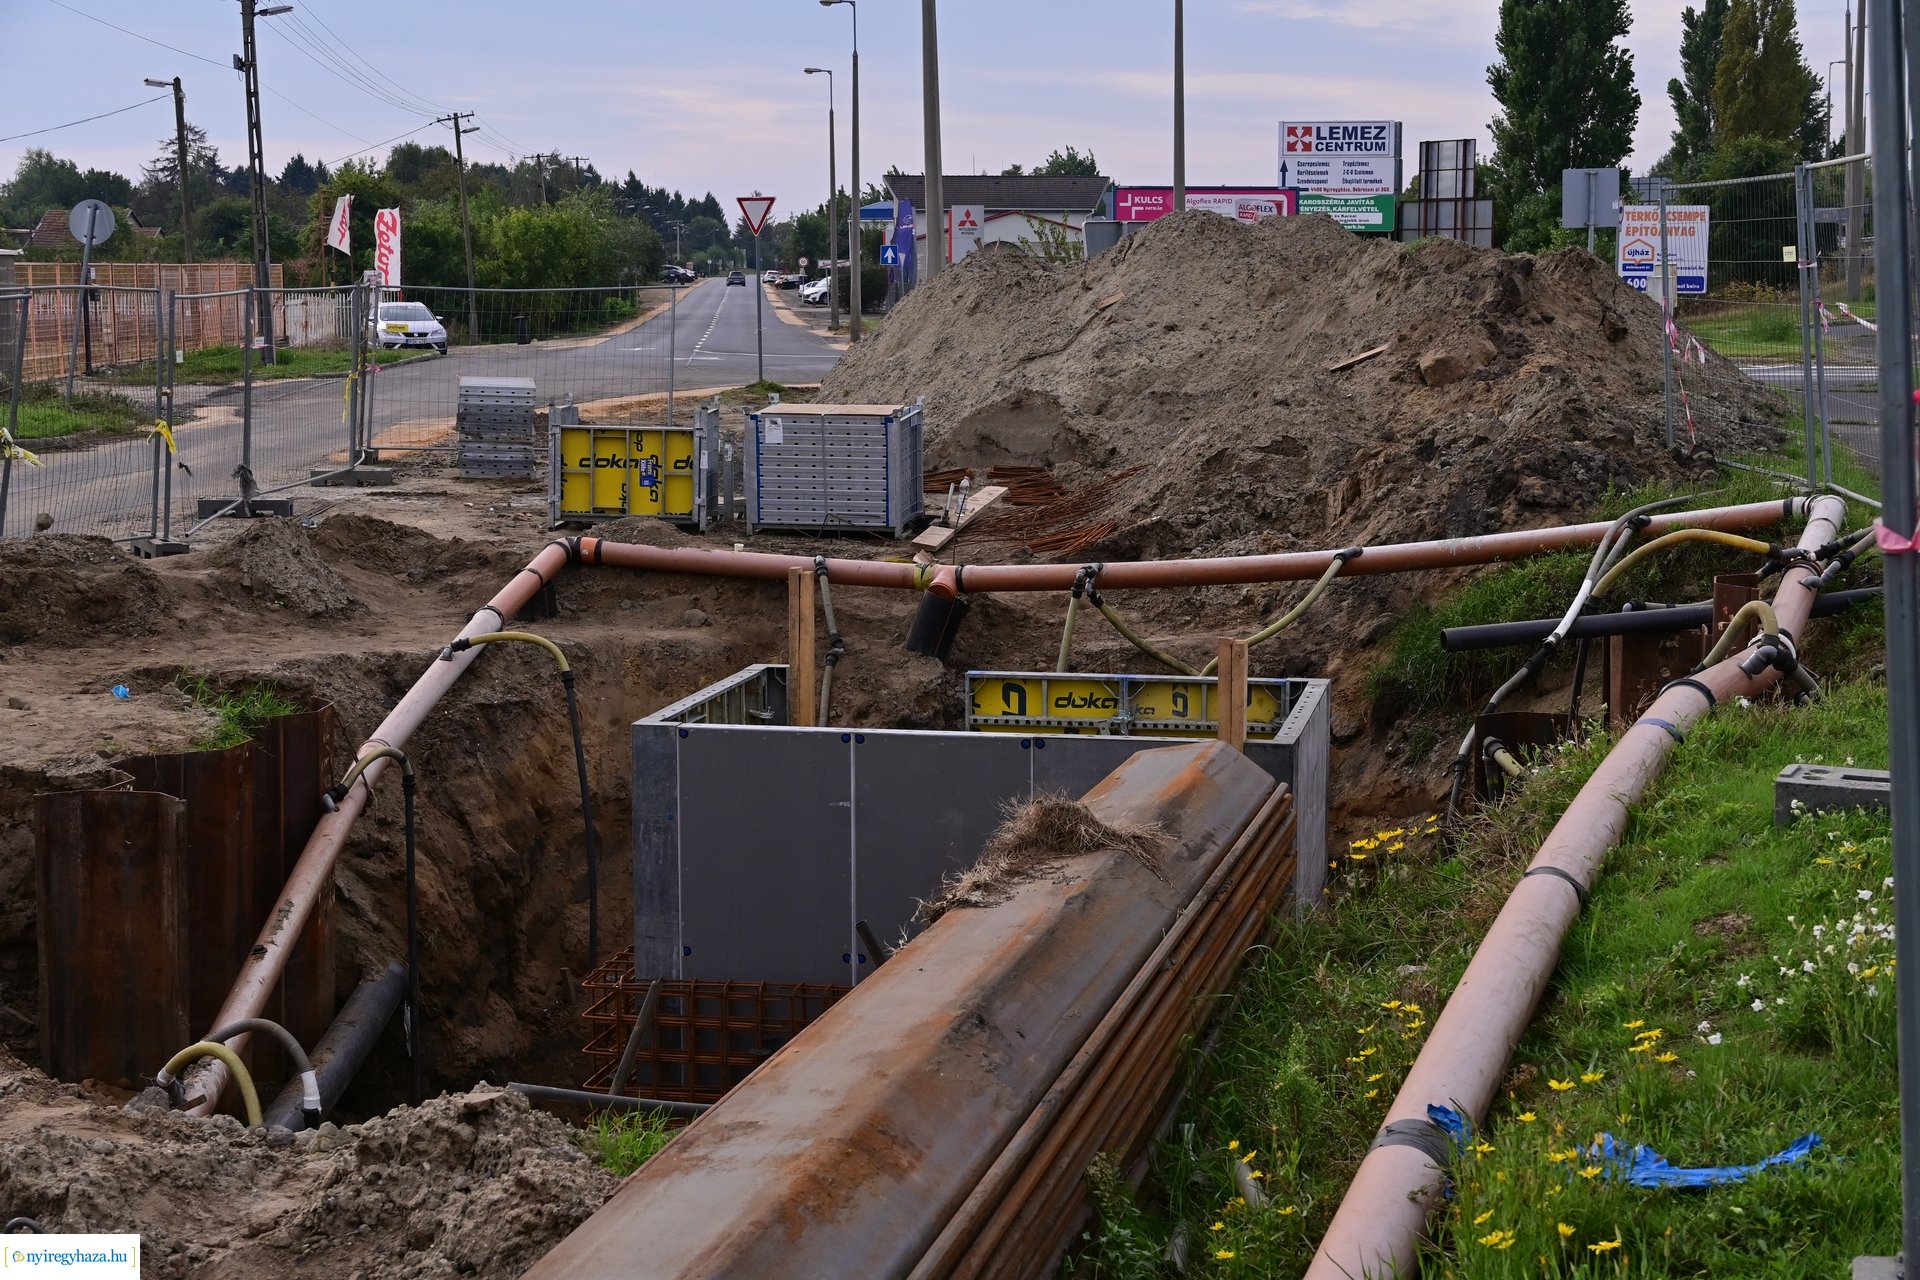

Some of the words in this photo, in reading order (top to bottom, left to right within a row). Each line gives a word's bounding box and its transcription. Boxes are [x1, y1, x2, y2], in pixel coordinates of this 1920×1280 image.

[1316, 126, 1386, 140] LEMEZ
[1315, 141, 1386, 152] CENTRUM
[1134, 196, 1164, 204] KULCS
[1186, 198, 1212, 206] Algoflex
[1238, 204, 1274, 213] ALGOFLEX
[1666, 211, 1706, 222] CSEMPE
[1627, 248, 1650, 257] újház
[579, 453, 640, 469] doka
[1054, 691, 1120, 709] doka
